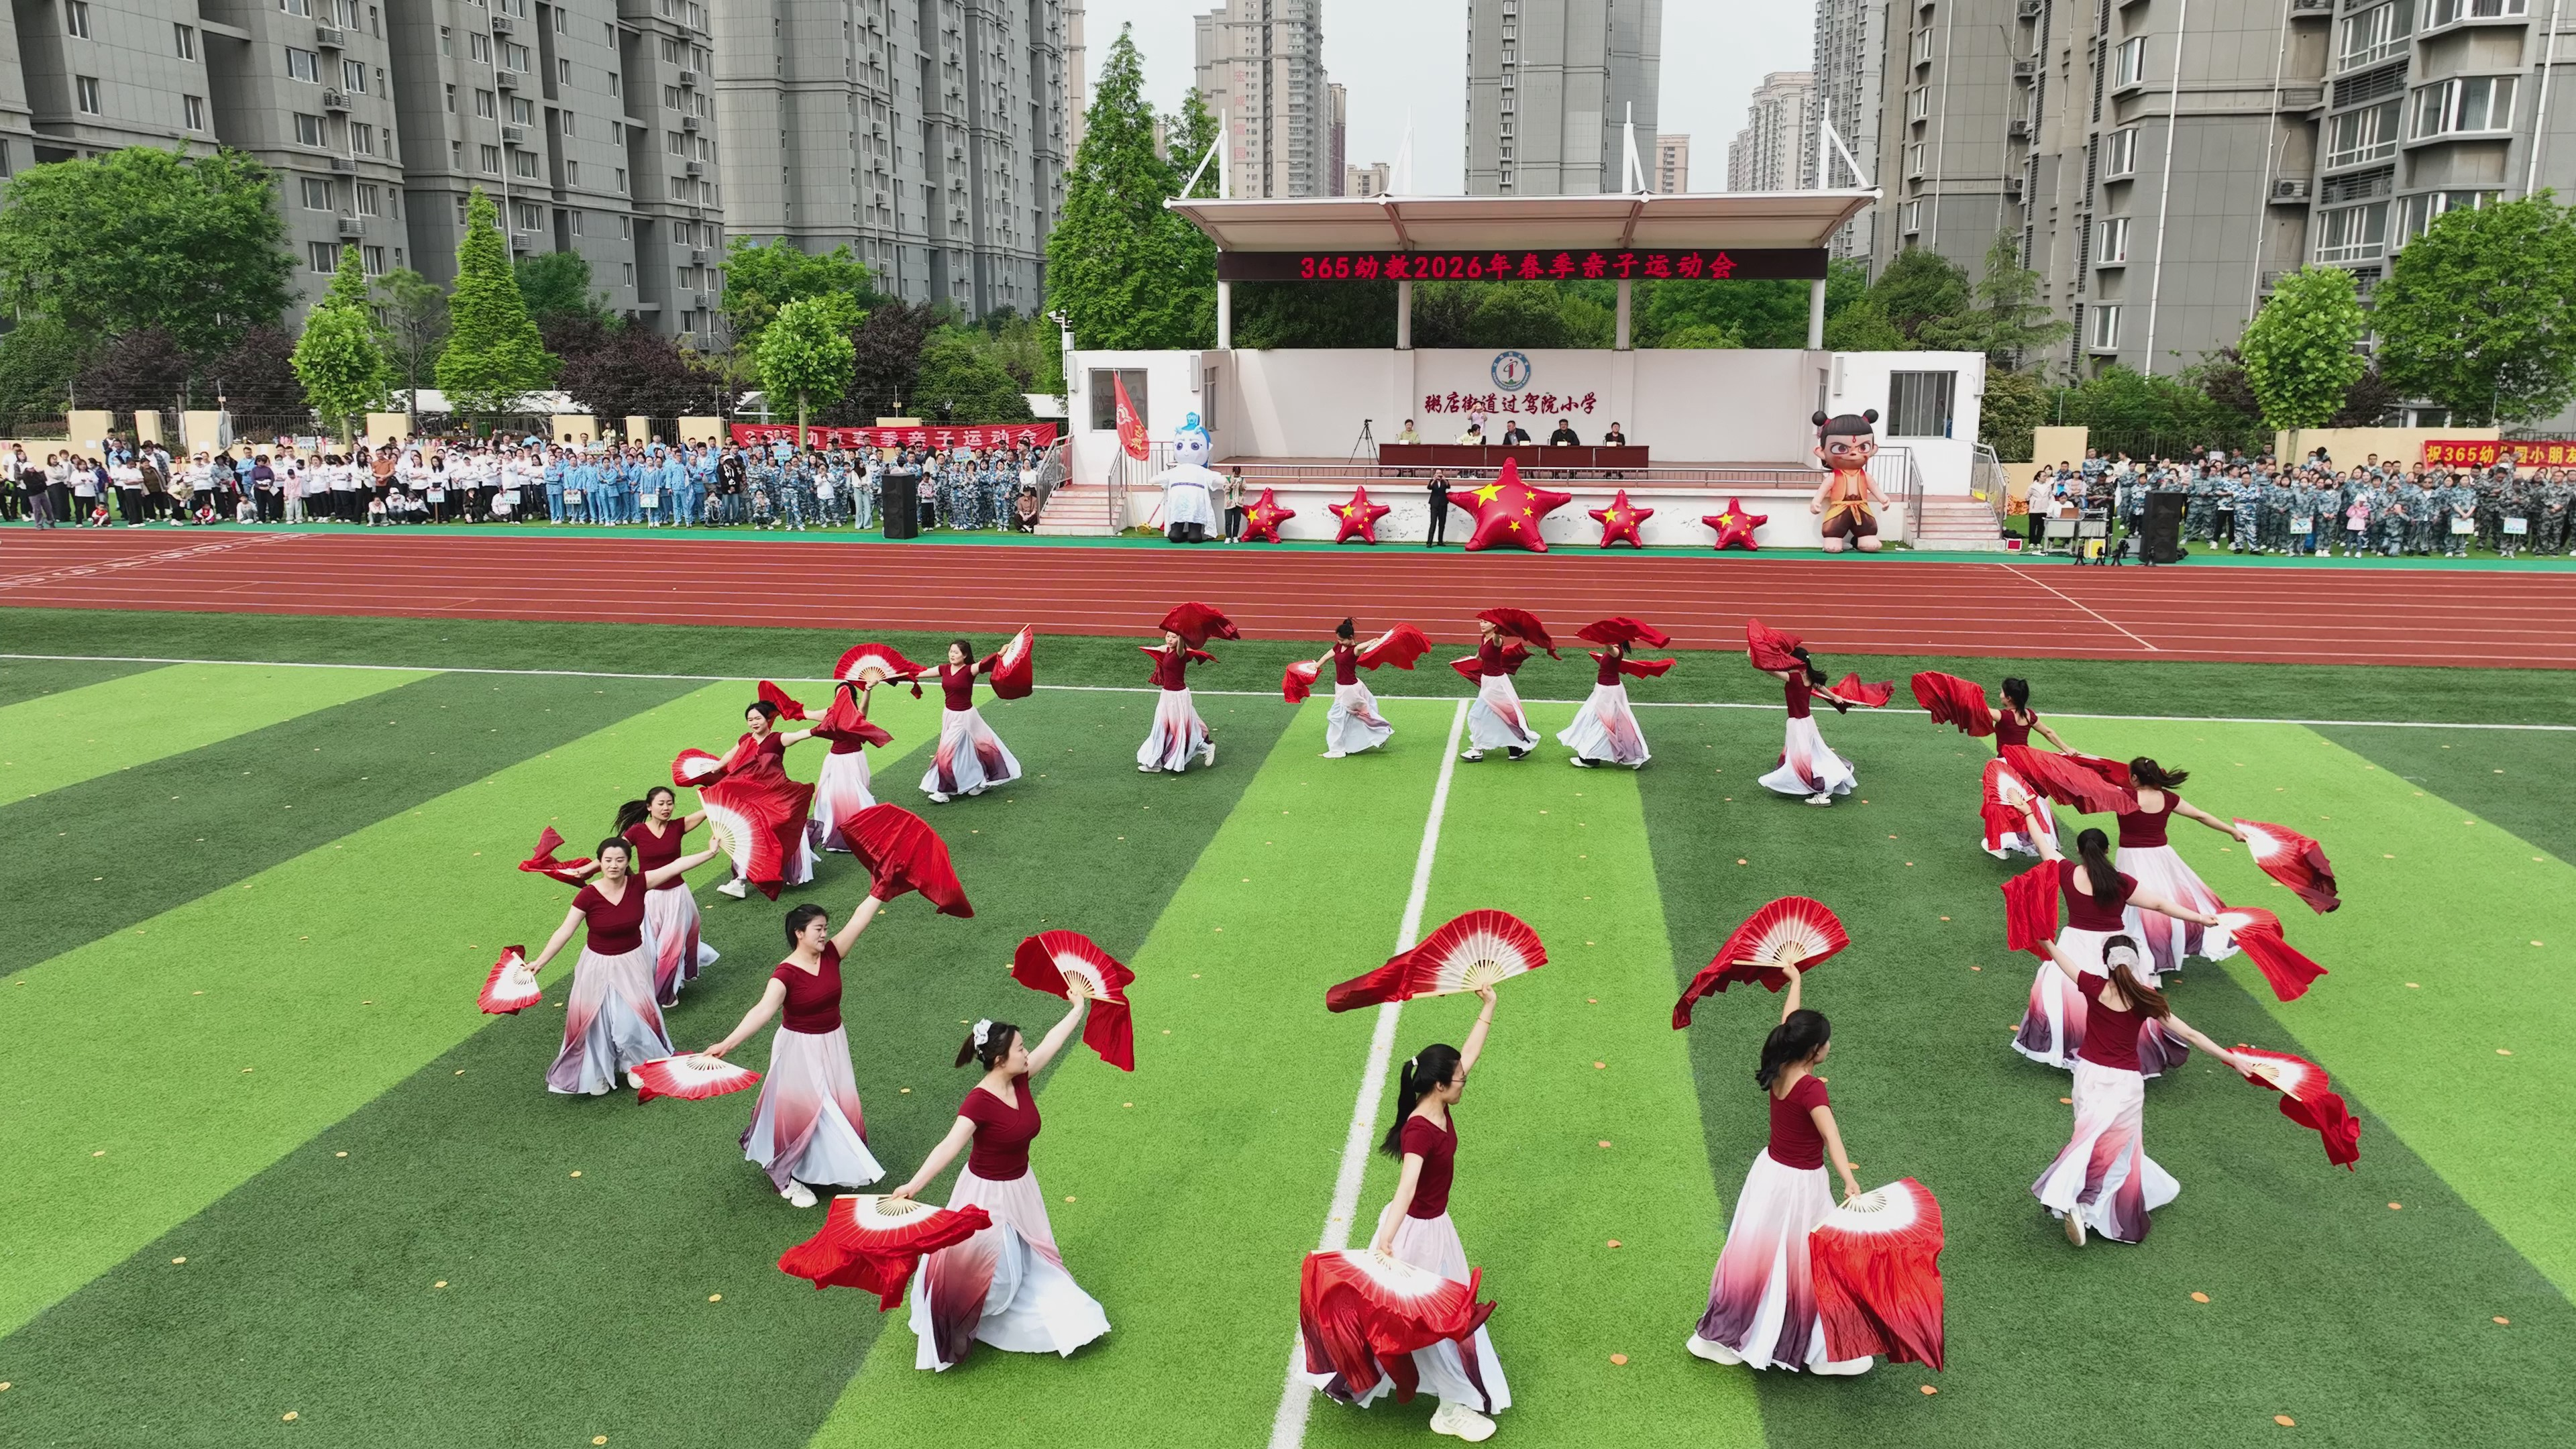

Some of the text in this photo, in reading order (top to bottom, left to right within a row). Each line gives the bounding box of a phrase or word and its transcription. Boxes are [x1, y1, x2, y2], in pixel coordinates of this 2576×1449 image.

[1234, 70, 1245, 159] 宏成富园
[1300, 252, 1737, 279] 365幼教2026年春季亲子运动会
[1424, 391, 1597, 415] 粥店街道过驾院小学
